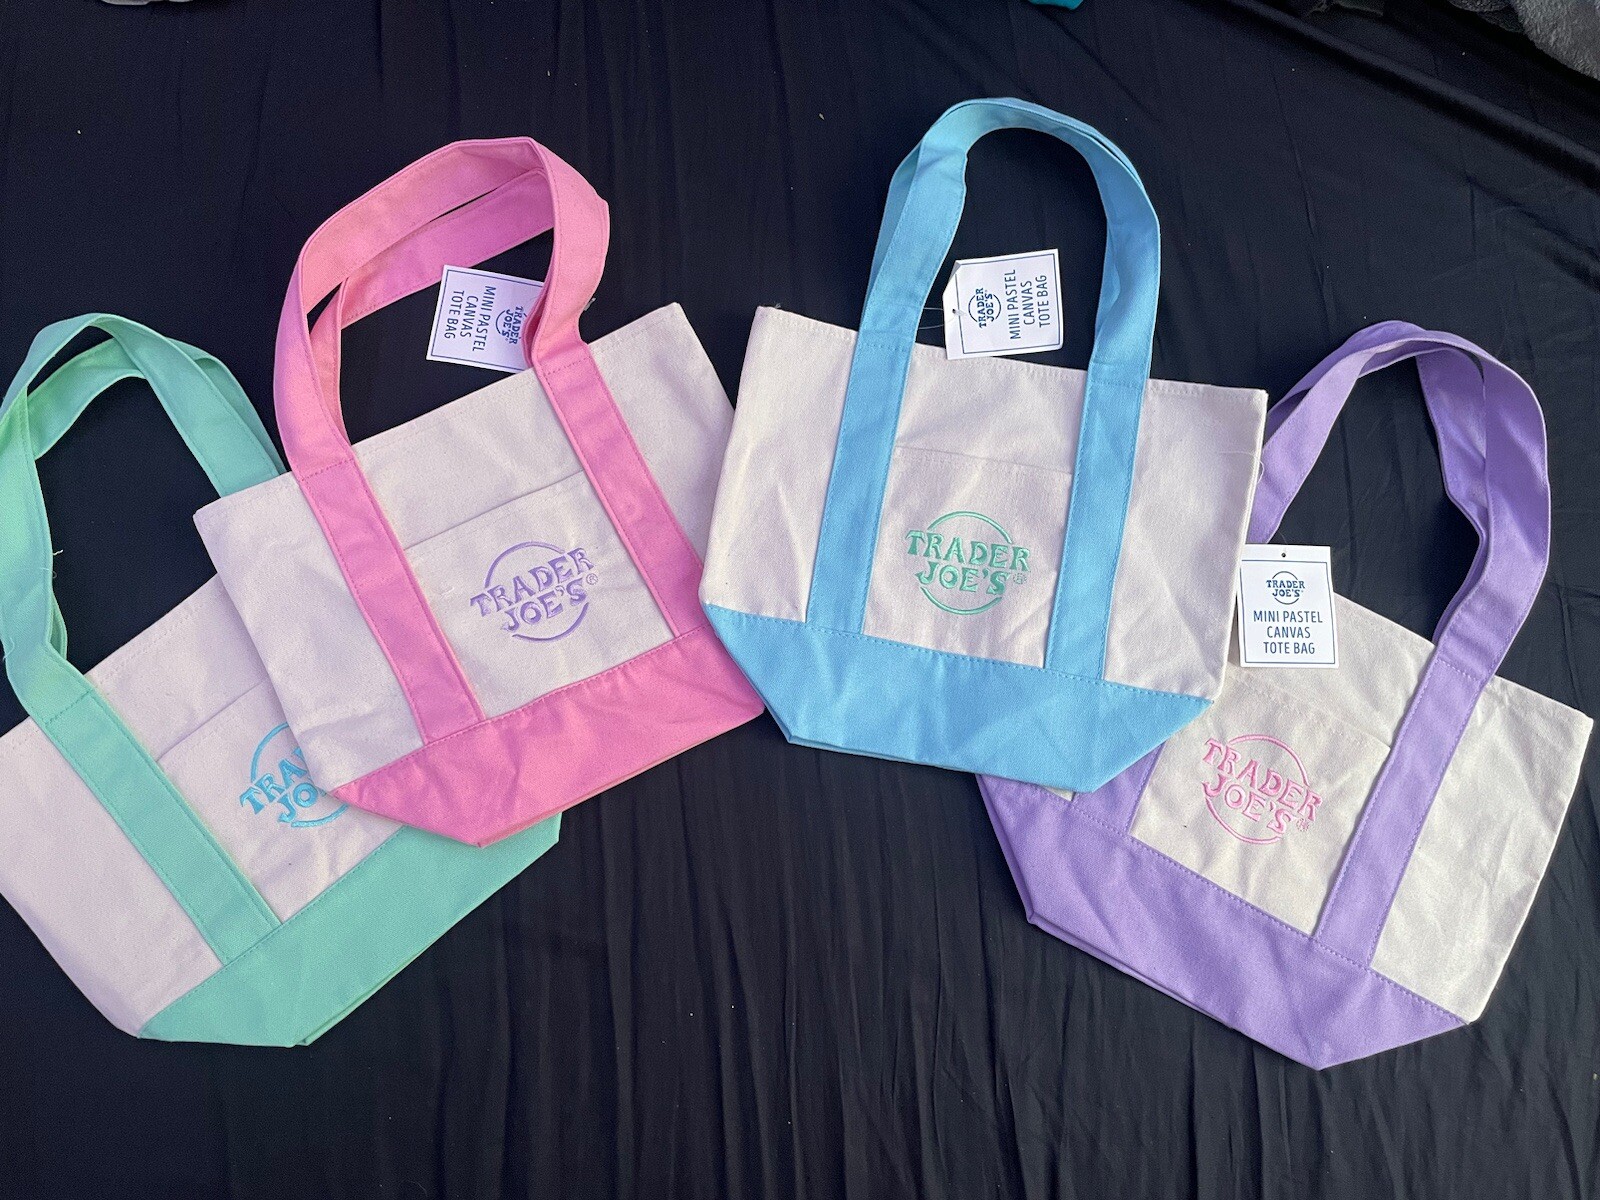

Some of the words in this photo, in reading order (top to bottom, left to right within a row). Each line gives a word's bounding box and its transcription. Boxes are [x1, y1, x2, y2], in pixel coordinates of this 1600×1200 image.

[449, 290, 464, 316] TOTE
[482, 285, 497, 312] MINI
[1004, 269, 1018, 311] PASTEL
[1020, 280, 1035, 325] CANVAS
[1035, 275, 1049, 297] BAG
[460, 295, 479, 338] CANVAS
[509, 306, 523, 345] TRADER
[975, 288, 987, 328] TRADER
[1037, 300, 1050, 328] TOTE
[444, 318, 459, 339] BAG
[472, 313, 491, 352] PASTEL
[1007, 316, 1021, 340] MINI
[905, 529, 1031, 572] TRADER
[470, 547, 594, 617] TRADER
[1266, 580, 1305, 589] TRADER
[1253, 610, 1279, 622] MINI
[1283, 611, 1323, 623] PASTEL
[1267, 626, 1311, 638] CANVAS
[1263, 642, 1290, 654] TOTE
[1294, 642, 1315, 654] BAG
[239, 747, 308, 815] TRA
[1202, 738, 1322, 821] TRADER
[277, 783, 327, 823] JO
